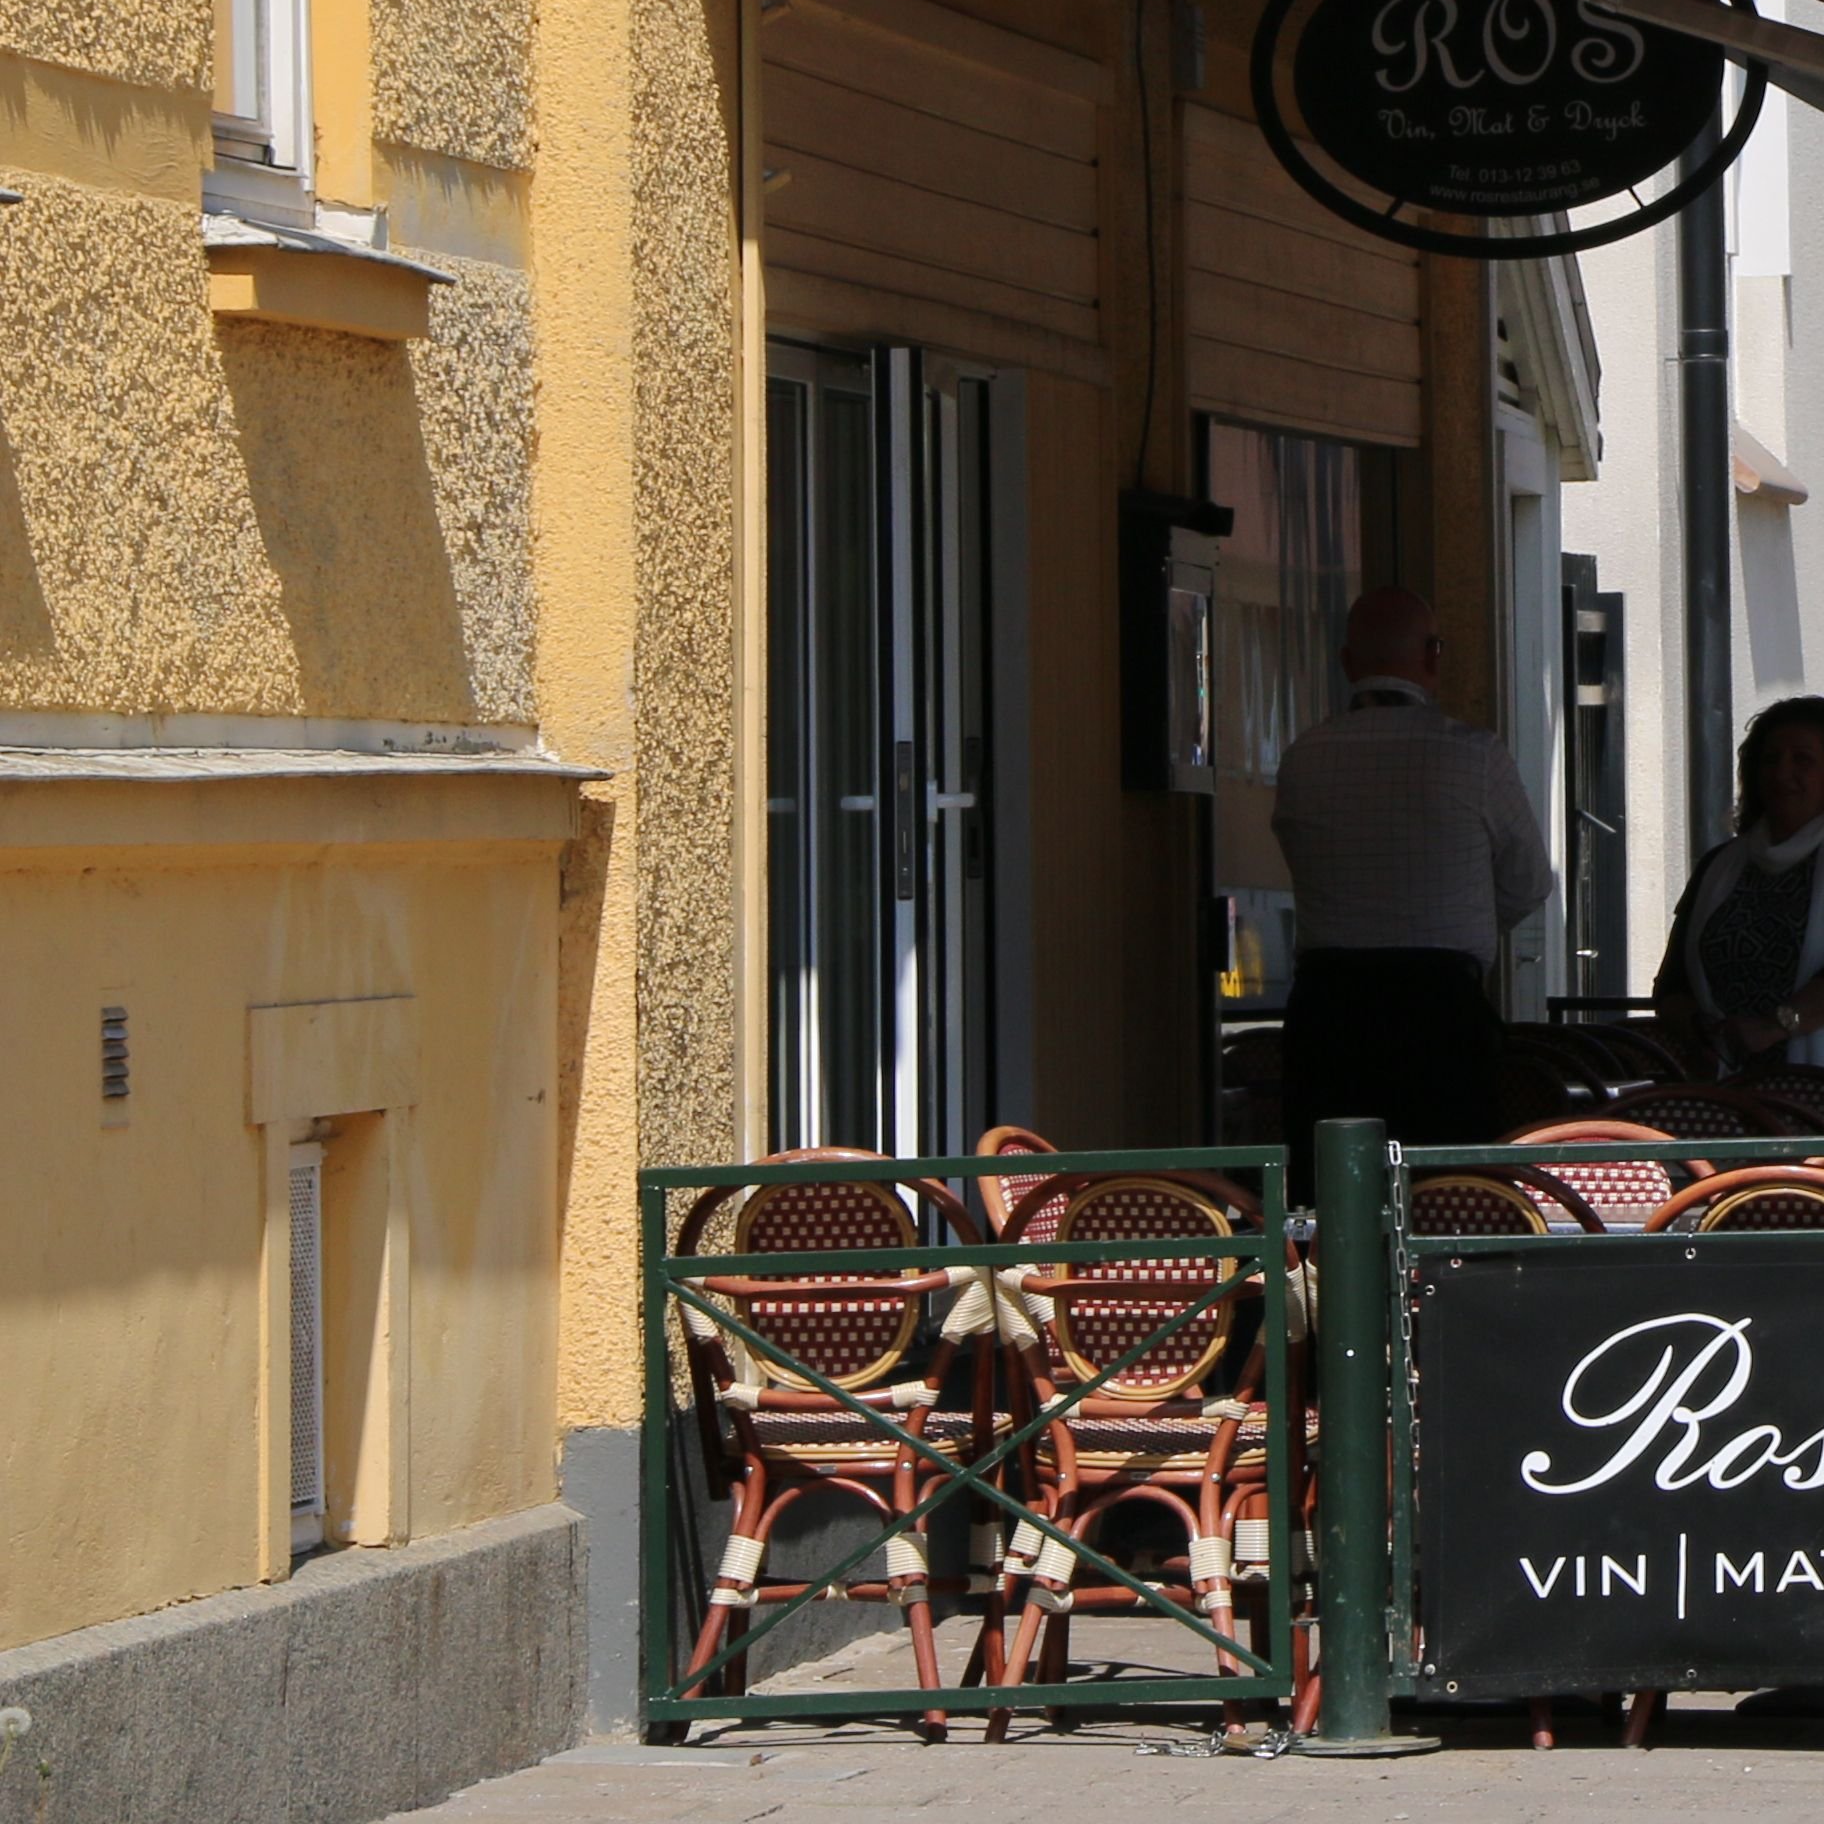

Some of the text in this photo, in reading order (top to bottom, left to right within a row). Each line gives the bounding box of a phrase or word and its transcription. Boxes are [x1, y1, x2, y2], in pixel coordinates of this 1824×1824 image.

[1378, 99, 1648, 141] Vin, Mat & Dryck
[1477, 167, 1532, 183] 013-12
[1536, 164, 1558, 180] 39
[1519, 1552, 1648, 1600] VIN
